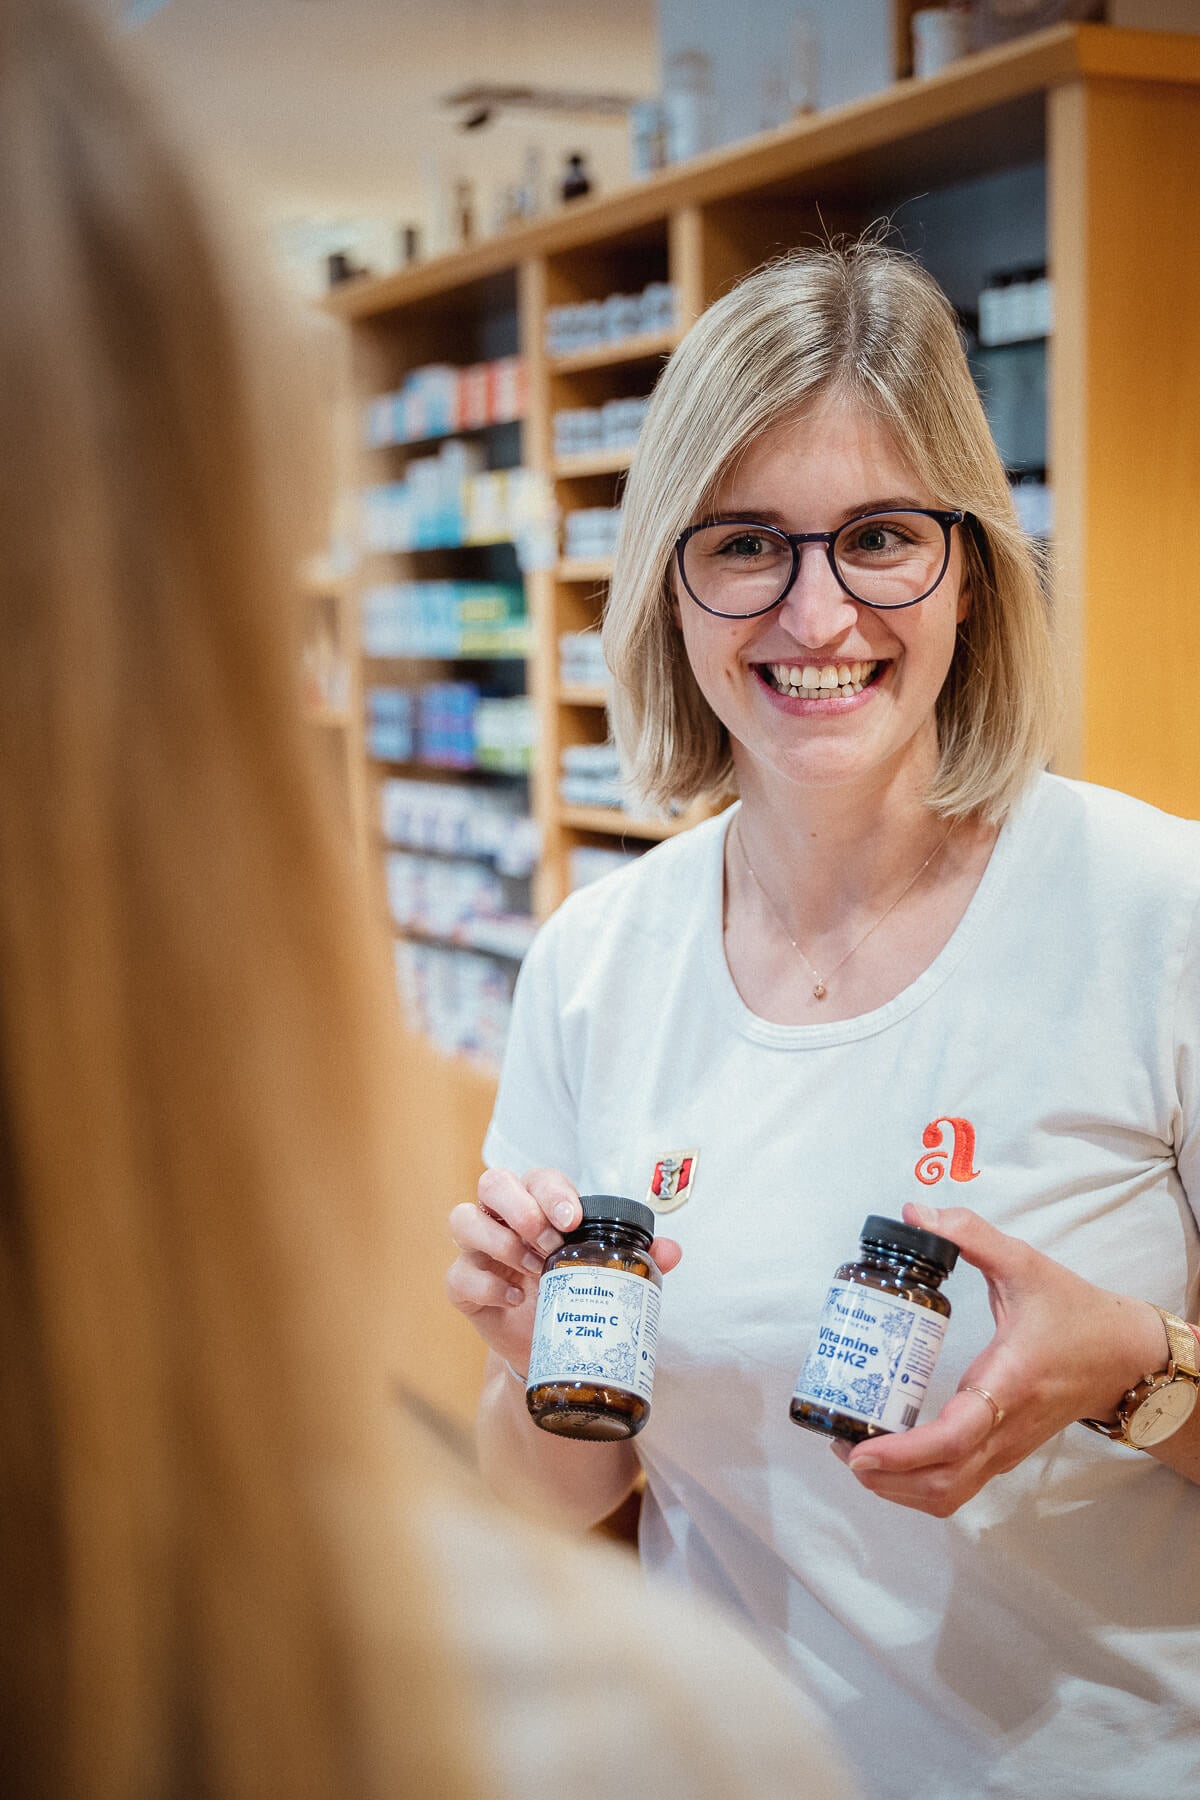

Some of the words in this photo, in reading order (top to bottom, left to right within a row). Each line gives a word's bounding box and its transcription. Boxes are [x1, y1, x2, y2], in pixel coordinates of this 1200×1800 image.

[568, 1286, 615, 1298] Nautilus
[556, 1312, 606, 1324] Vitamin
[609, 1315, 619, 1326] C
[836, 1303, 877, 1325] Nautilus
[565, 1328, 573, 1336] +
[575, 1326, 603, 1339] Zink
[819, 1326, 879, 1356] Vitamine
[817, 1343, 867, 1369] D3+K2
